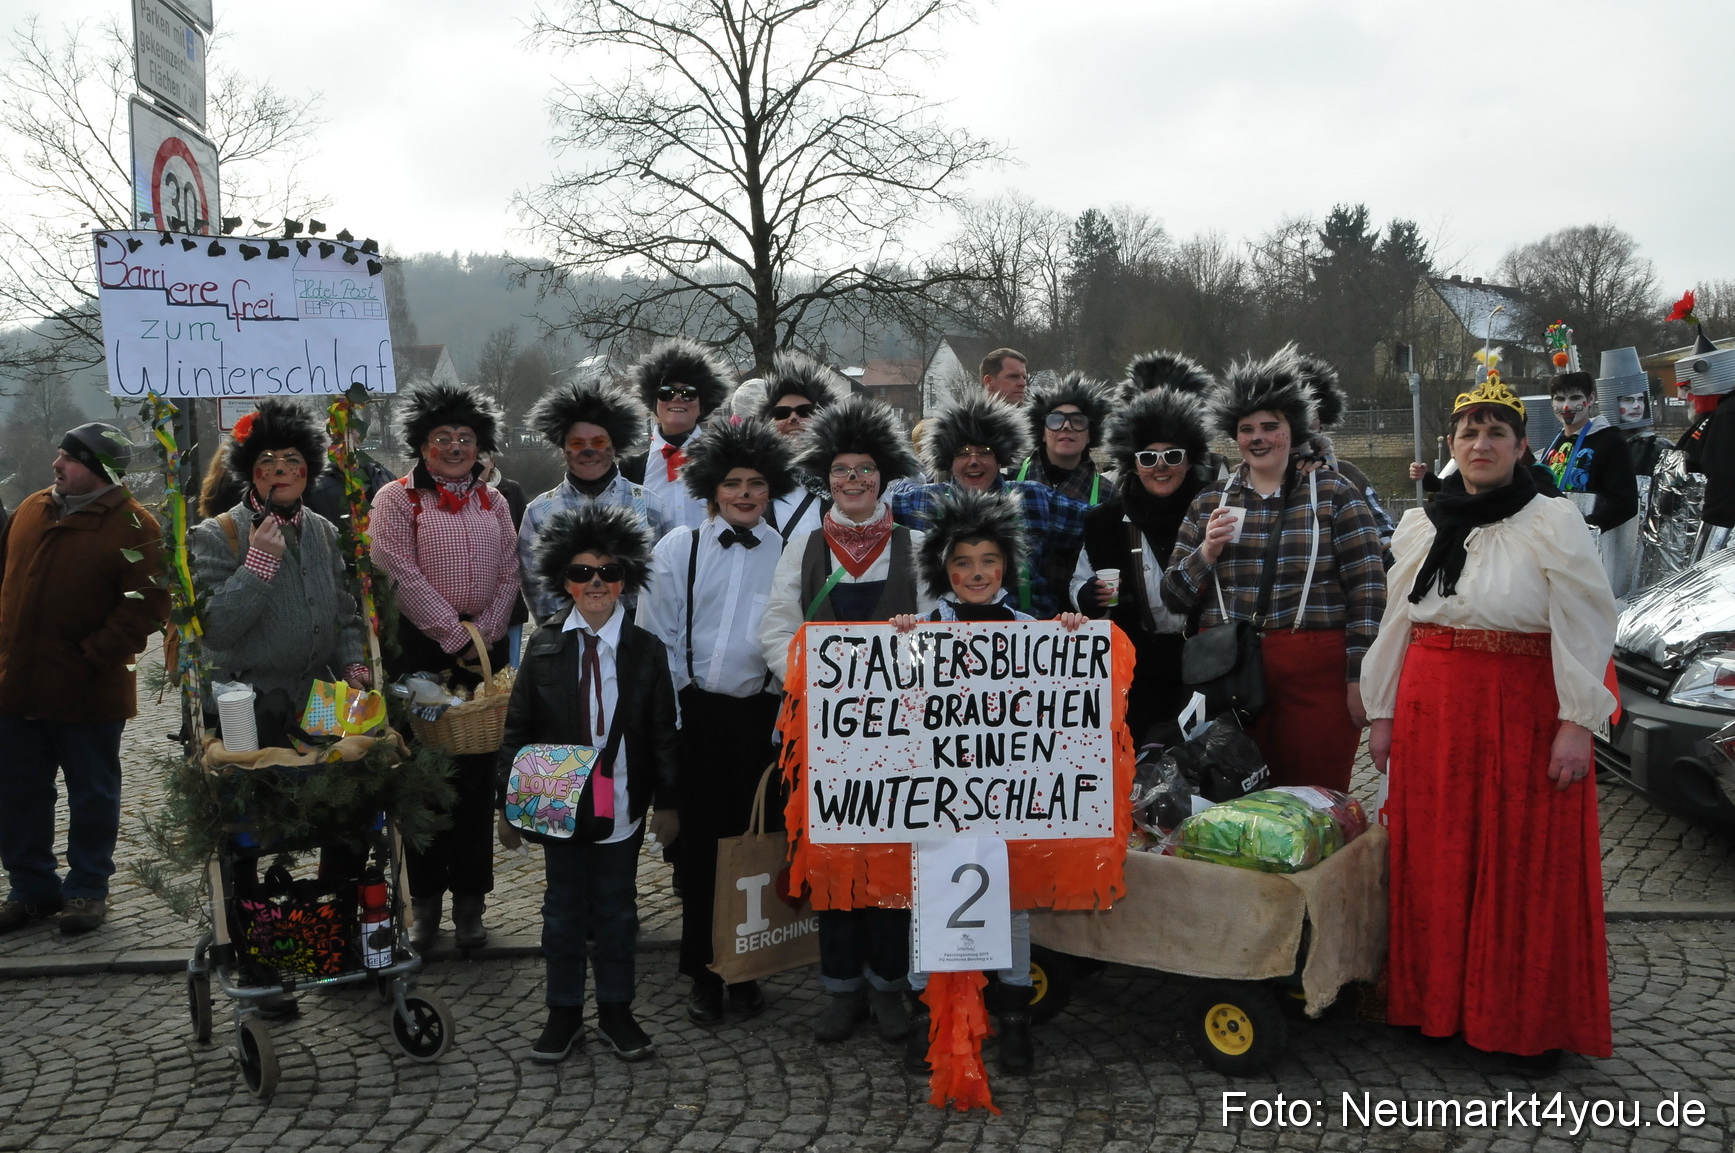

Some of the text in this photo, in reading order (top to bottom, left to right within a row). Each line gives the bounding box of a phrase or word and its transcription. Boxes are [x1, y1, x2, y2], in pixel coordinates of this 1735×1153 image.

[140, 0, 170, 37] Parken
[173, 25, 186, 50] mit
[149, 59, 180, 99] Flächen
[165, 172, 198, 236] 30
[97, 232, 281, 332] Barriere frei
[295, 278, 377, 299] Hotel Post
[140, 319, 221, 342] zum
[116, 337, 391, 396] Winterschlaf
[817, 631, 1110, 691] STAUFERSBUCHER
[821, 688, 1101, 738] IGEL BRAUCHEN
[932, 730, 1056, 769] KEINEN
[519, 774, 571, 798] LOVE
[813, 772, 1099, 833] WINTERSCHLAF
[736, 872, 771, 937] I
[946, 863, 990, 928] 2
[735, 916, 820, 954] BERCHING
